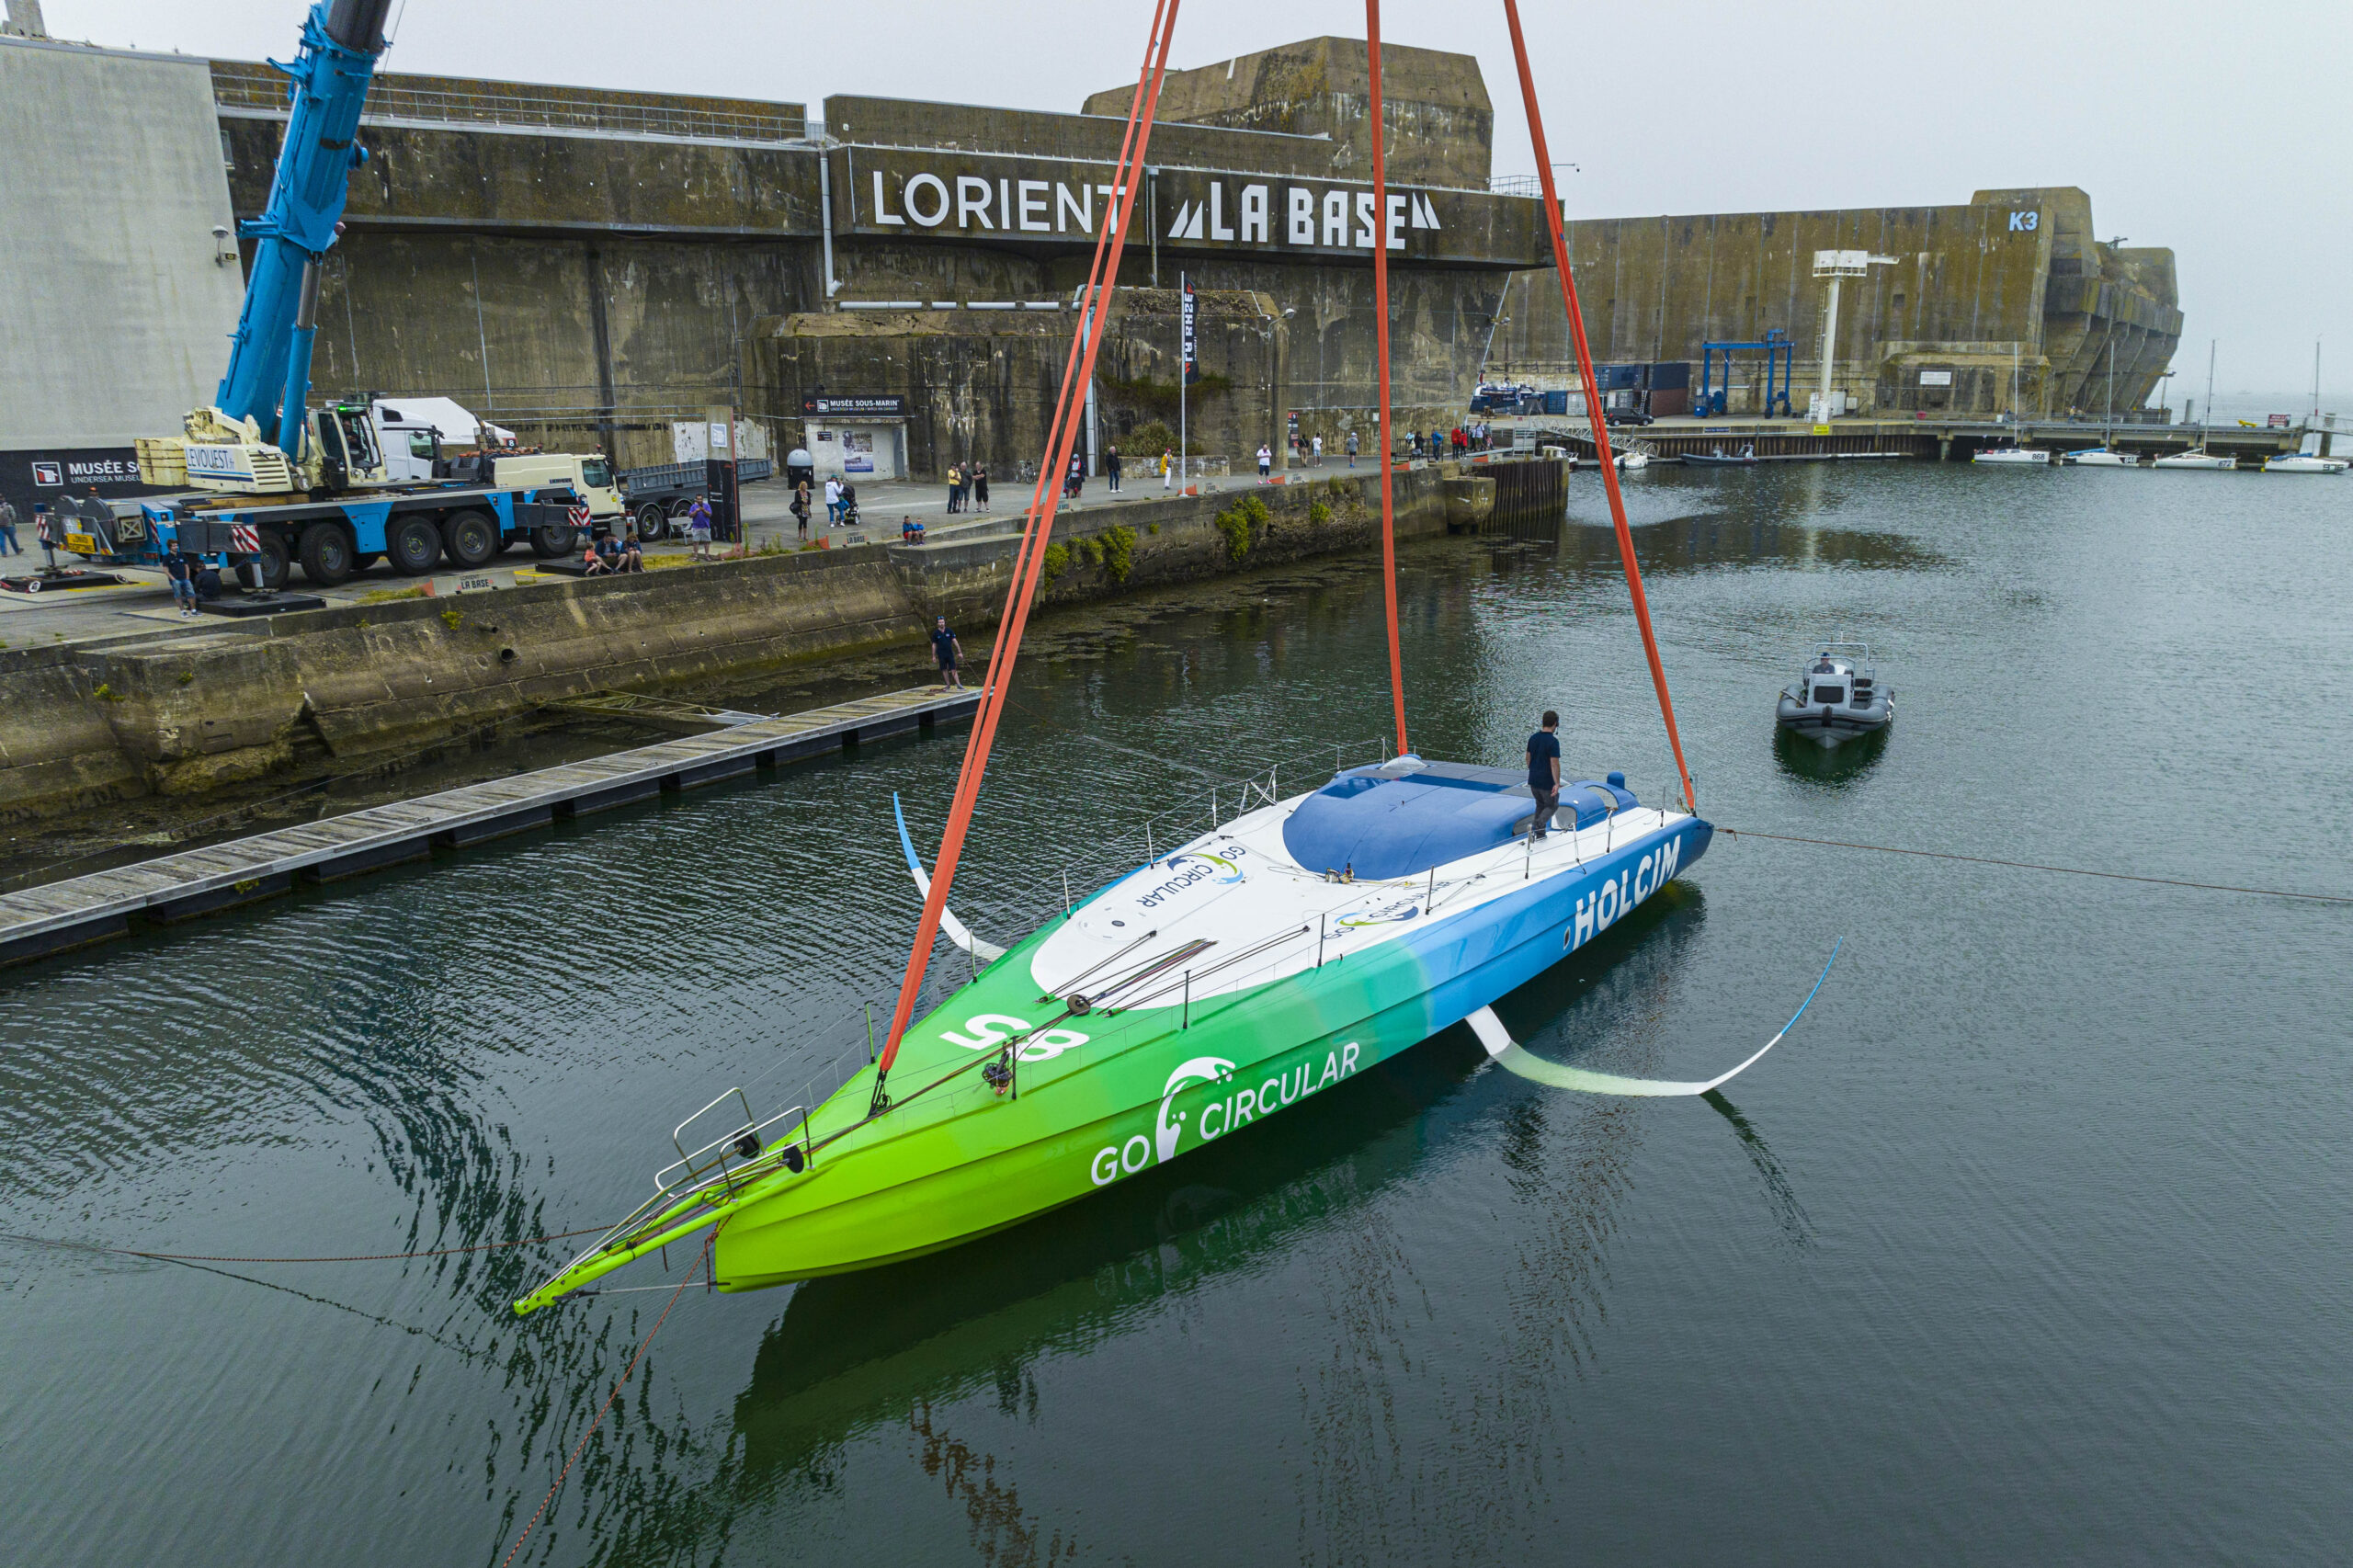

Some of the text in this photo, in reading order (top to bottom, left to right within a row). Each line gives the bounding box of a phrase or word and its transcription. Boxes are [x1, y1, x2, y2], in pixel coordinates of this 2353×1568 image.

[873, 171, 1127, 234] LORIENT
[1211, 182, 1406, 250] LA BASE
[2009, 211, 2039, 231] K3
[830, 399, 854, 407] MUSÉE
[69, 460, 141, 475] MUSÉE S
[71, 475, 114, 483] UNDERSEA
[461, 579, 490, 589] LA BASE
[1136, 846, 1246, 908] GO CIRCULAR
[1573, 835, 1681, 950] HOLCIM
[1090, 1041, 1360, 1186] GO CIRCULAR
